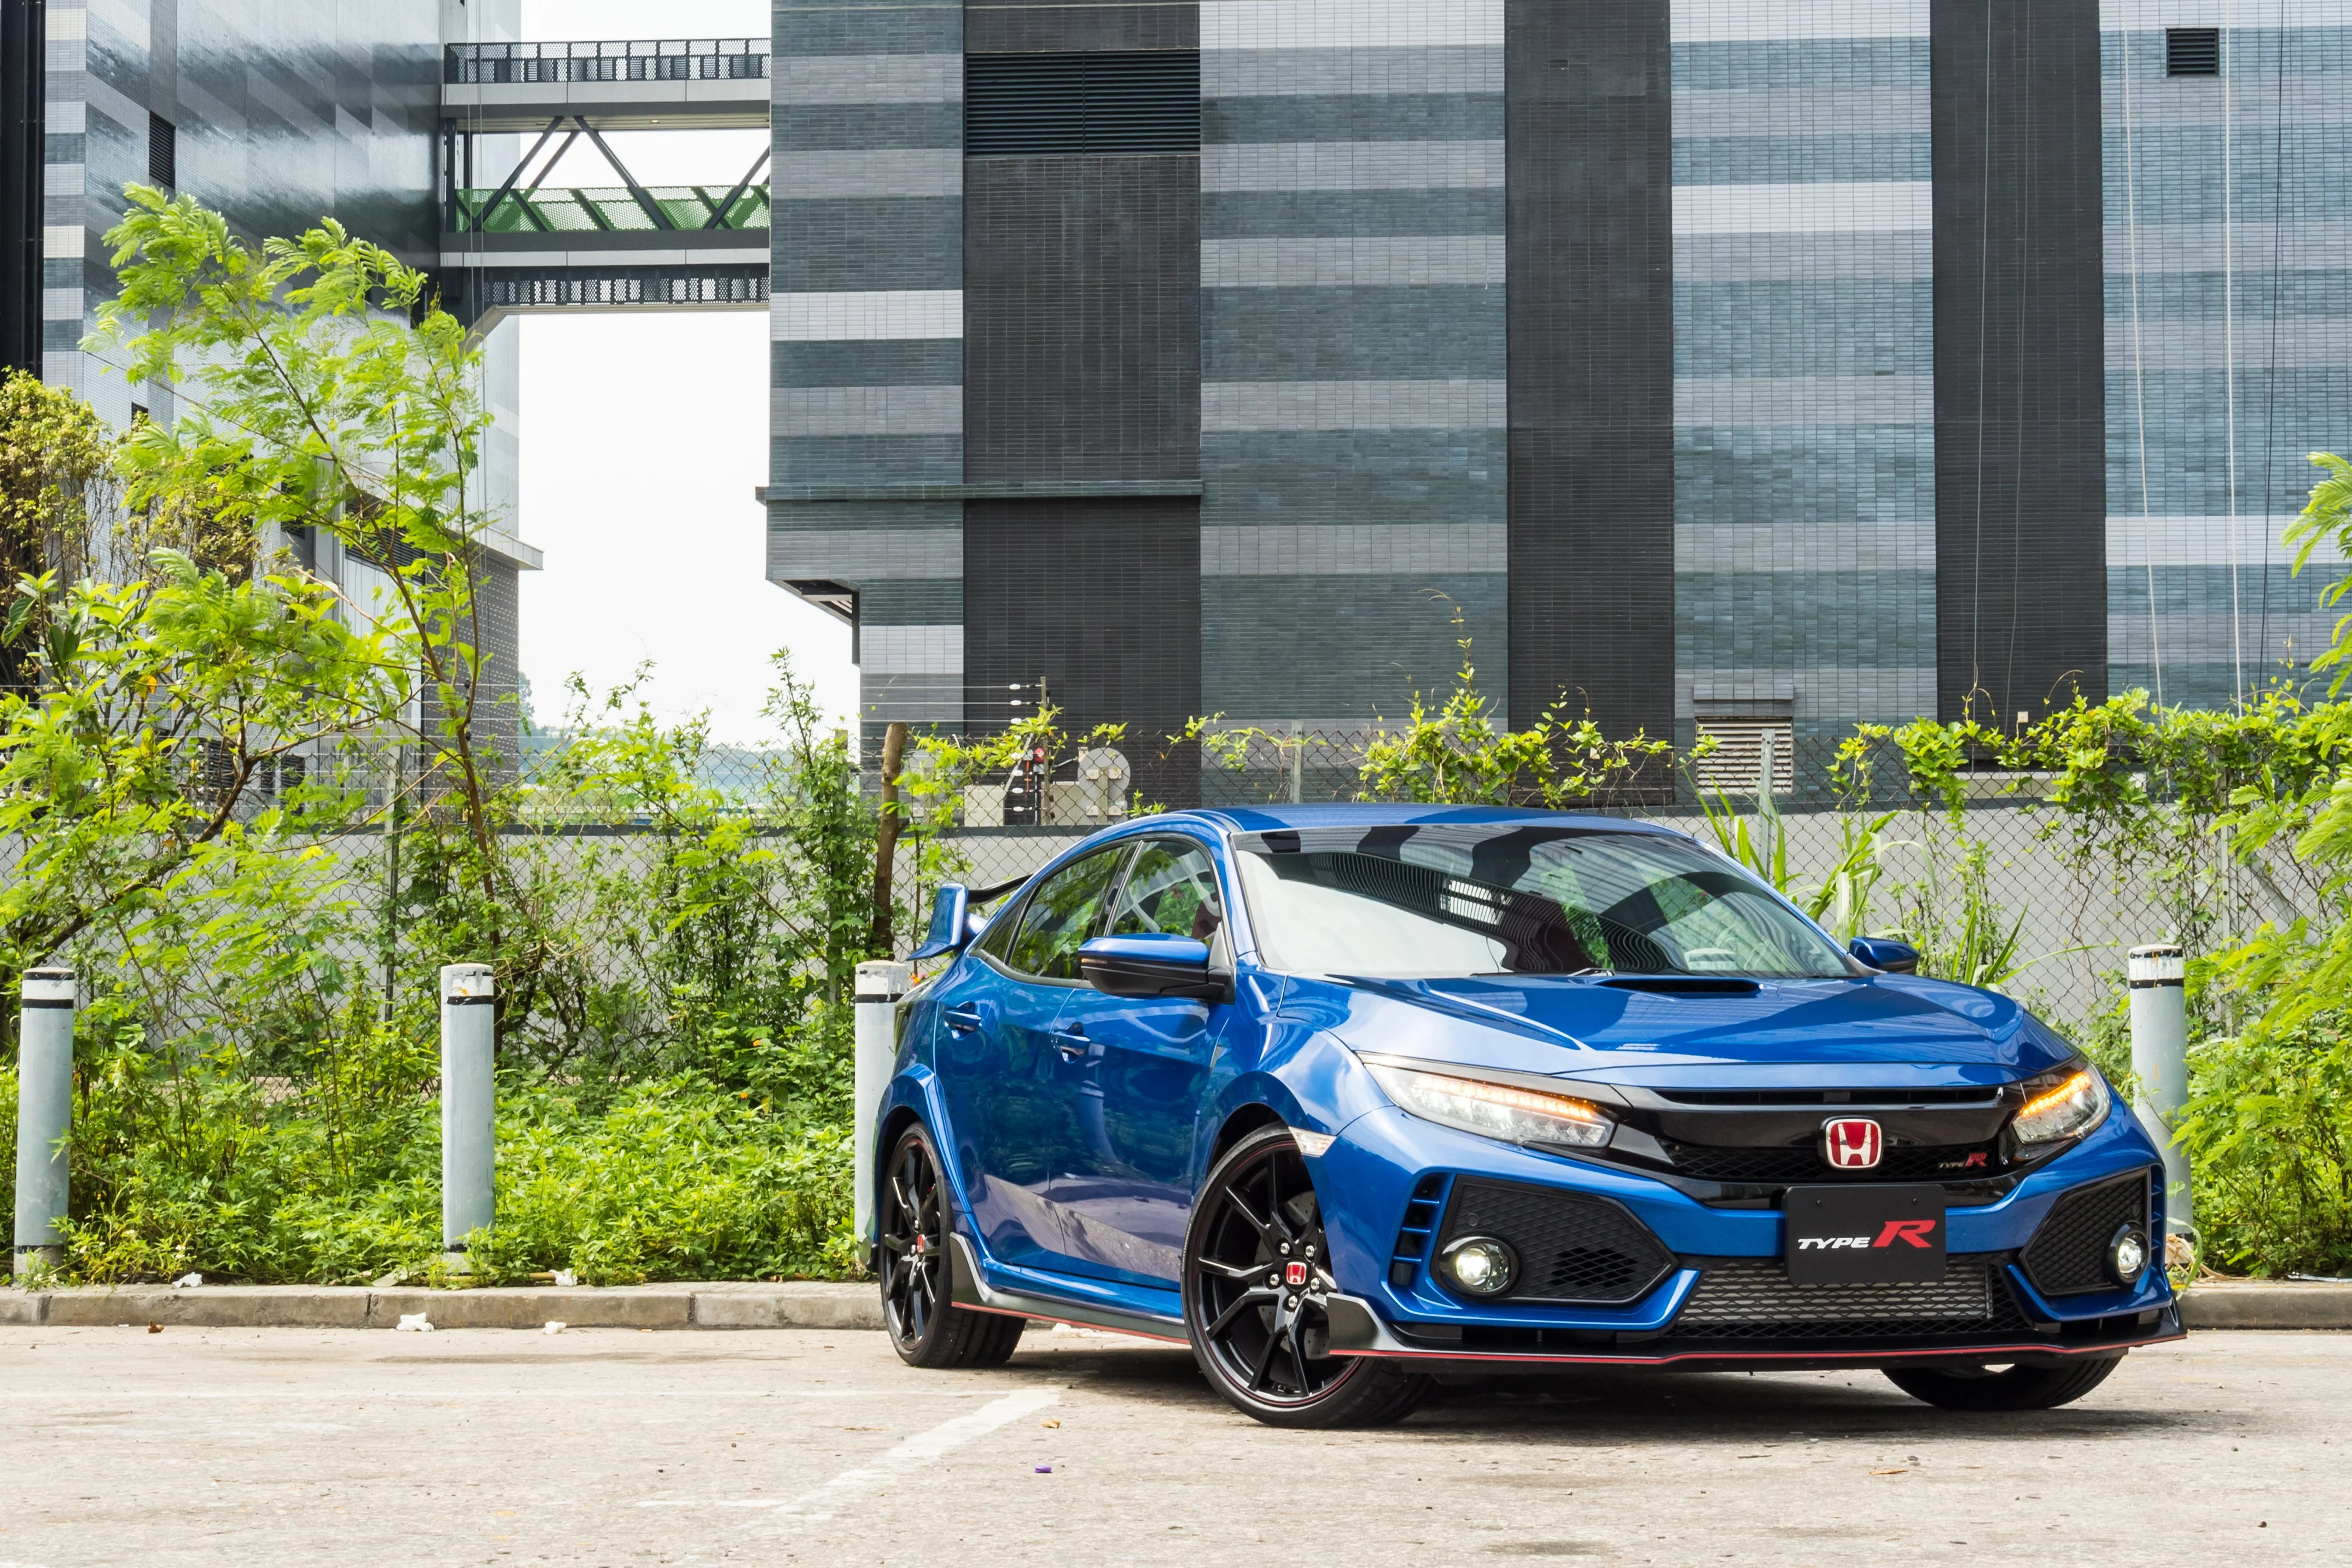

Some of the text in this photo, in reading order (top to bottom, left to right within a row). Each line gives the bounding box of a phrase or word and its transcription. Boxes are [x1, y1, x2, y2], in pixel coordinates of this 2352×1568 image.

[1965, 1152, 1987, 1167] R
[1798, 1220, 1936, 1250] TYPE R
